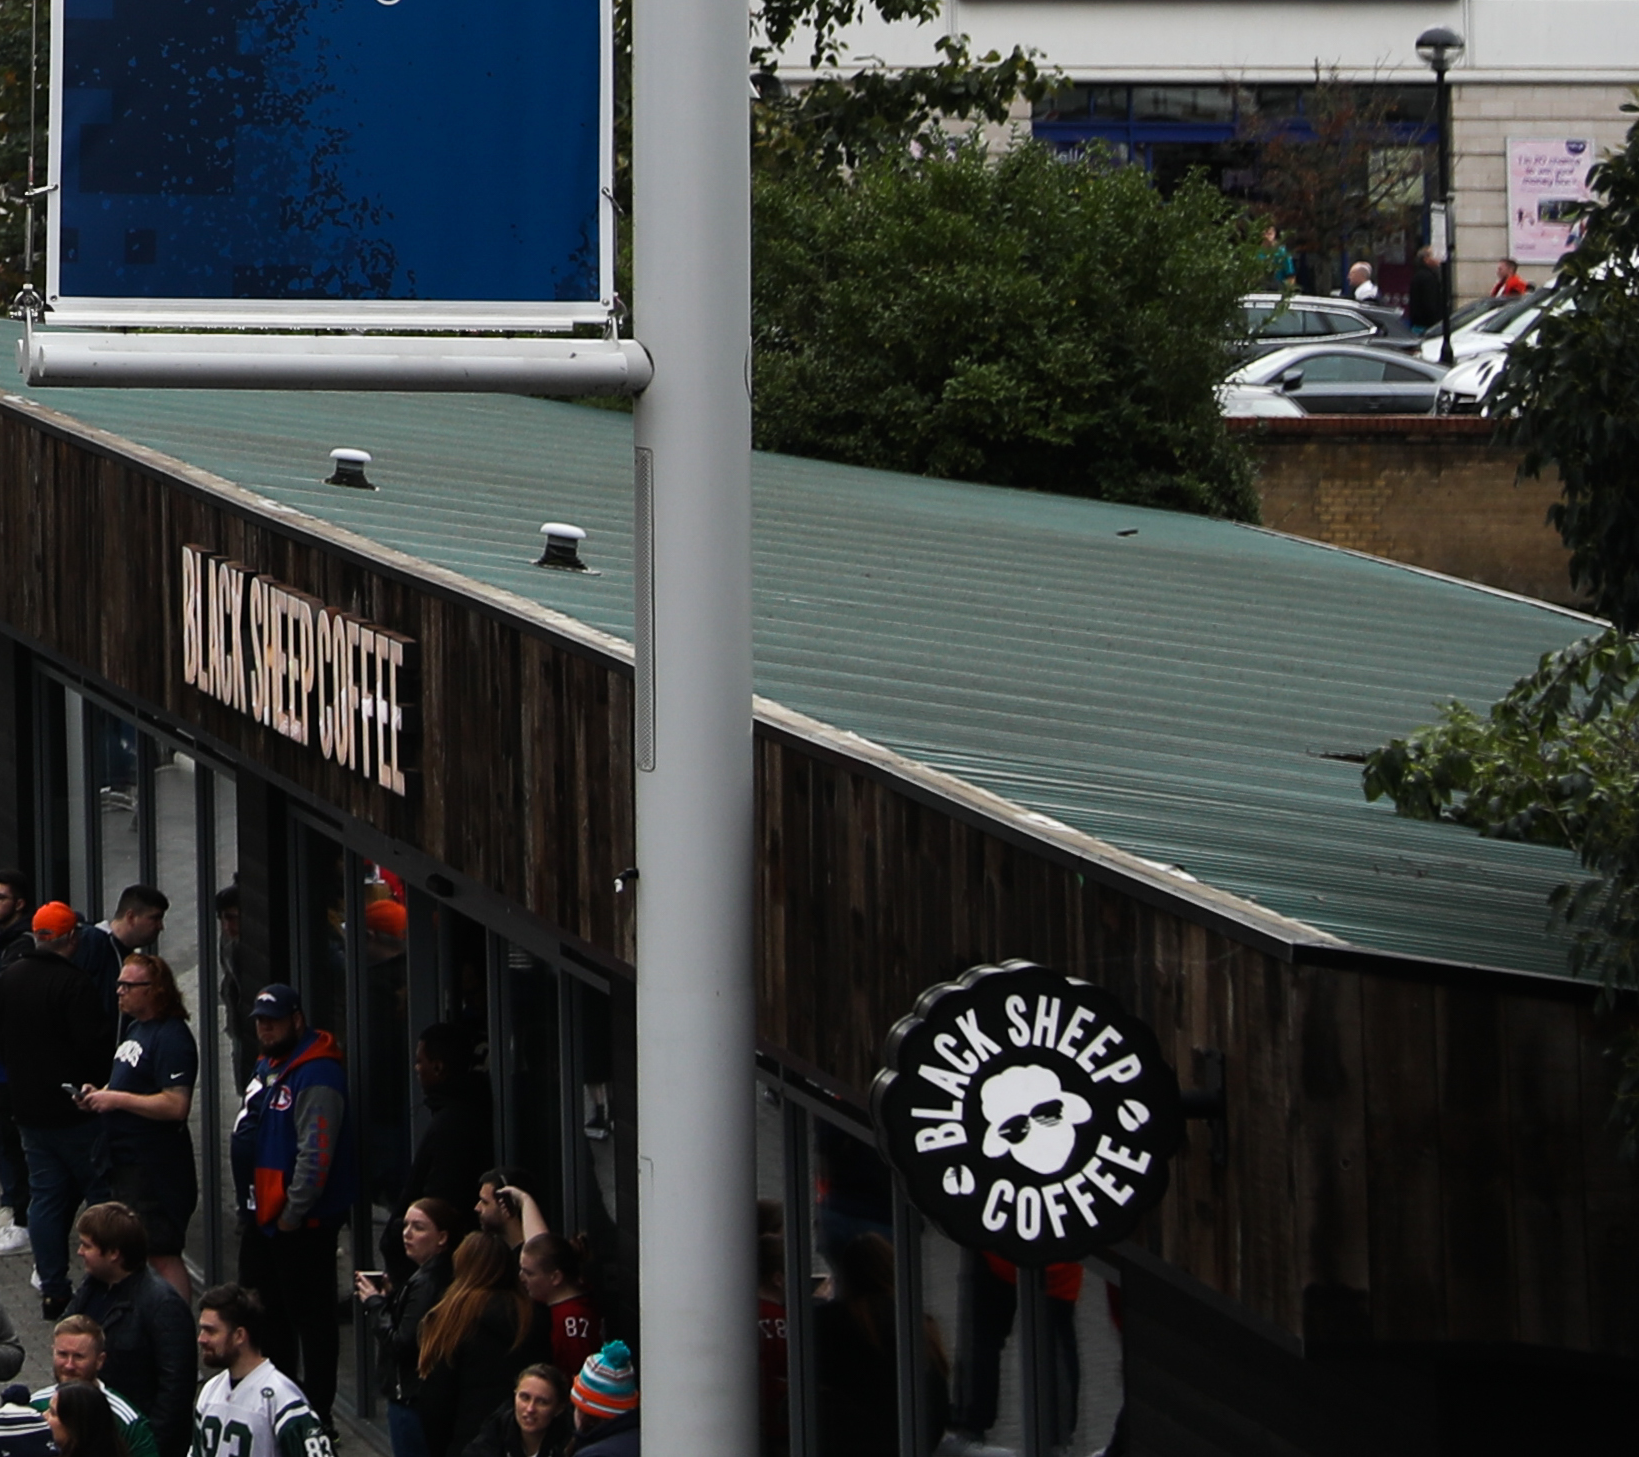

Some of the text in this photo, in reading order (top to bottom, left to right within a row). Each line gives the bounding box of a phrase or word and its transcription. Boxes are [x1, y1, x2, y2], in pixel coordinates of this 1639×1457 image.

[182, 545, 406, 798] BLACK SHEEP COFFEE
[910, 994, 1143, 1154] BLACK SHEEP
[982, 1134, 1152, 1241] COFFEE
[564, 1315, 590, 1338] 87
